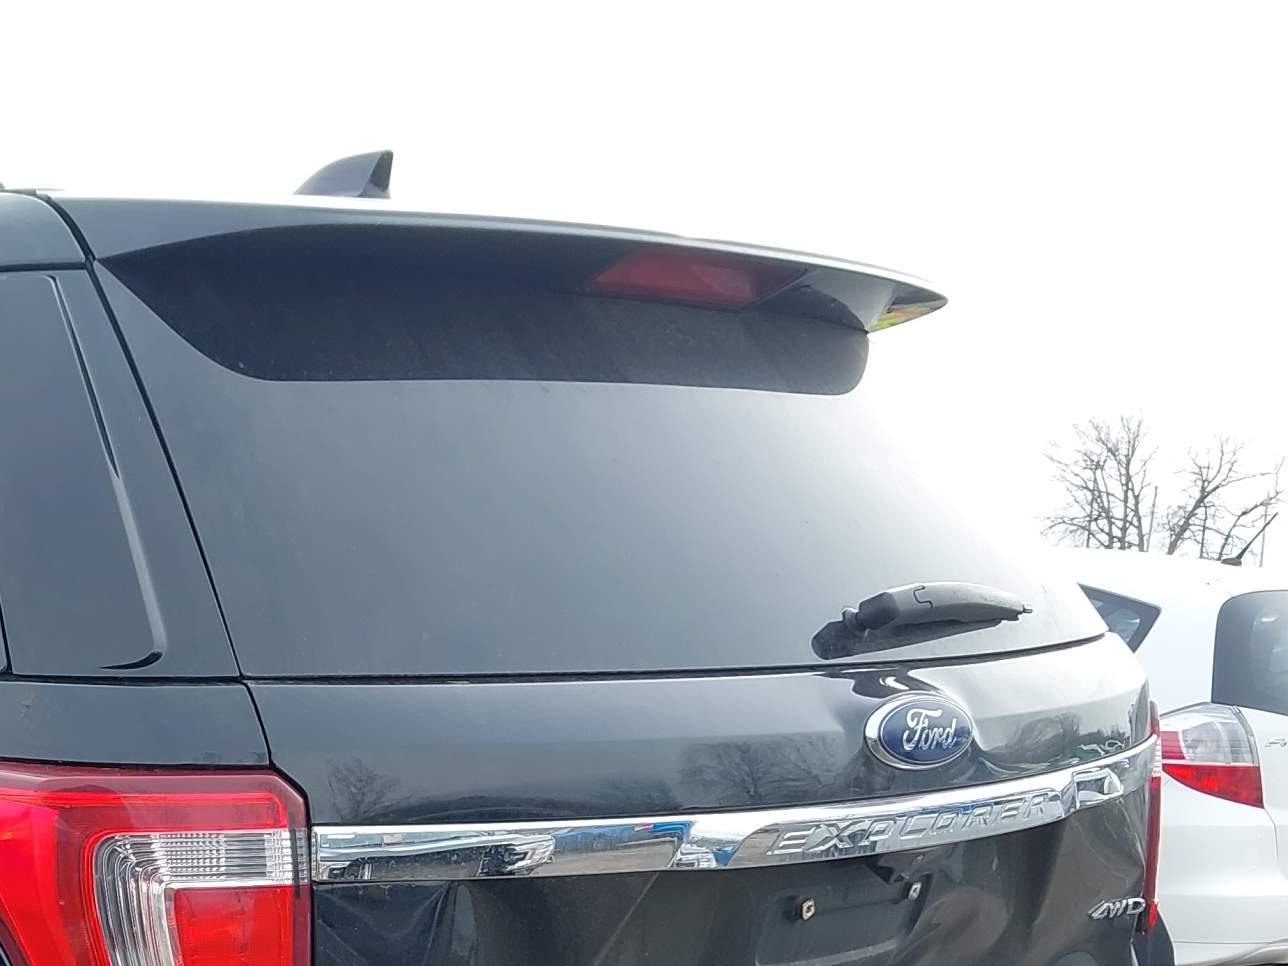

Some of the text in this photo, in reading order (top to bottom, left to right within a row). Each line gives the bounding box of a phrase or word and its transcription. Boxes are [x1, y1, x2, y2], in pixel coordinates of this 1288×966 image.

[902, 708, 958, 751] Ford
[766, 792, 1050, 856] EXPLORER
[1087, 897, 1146, 920] 4WD
